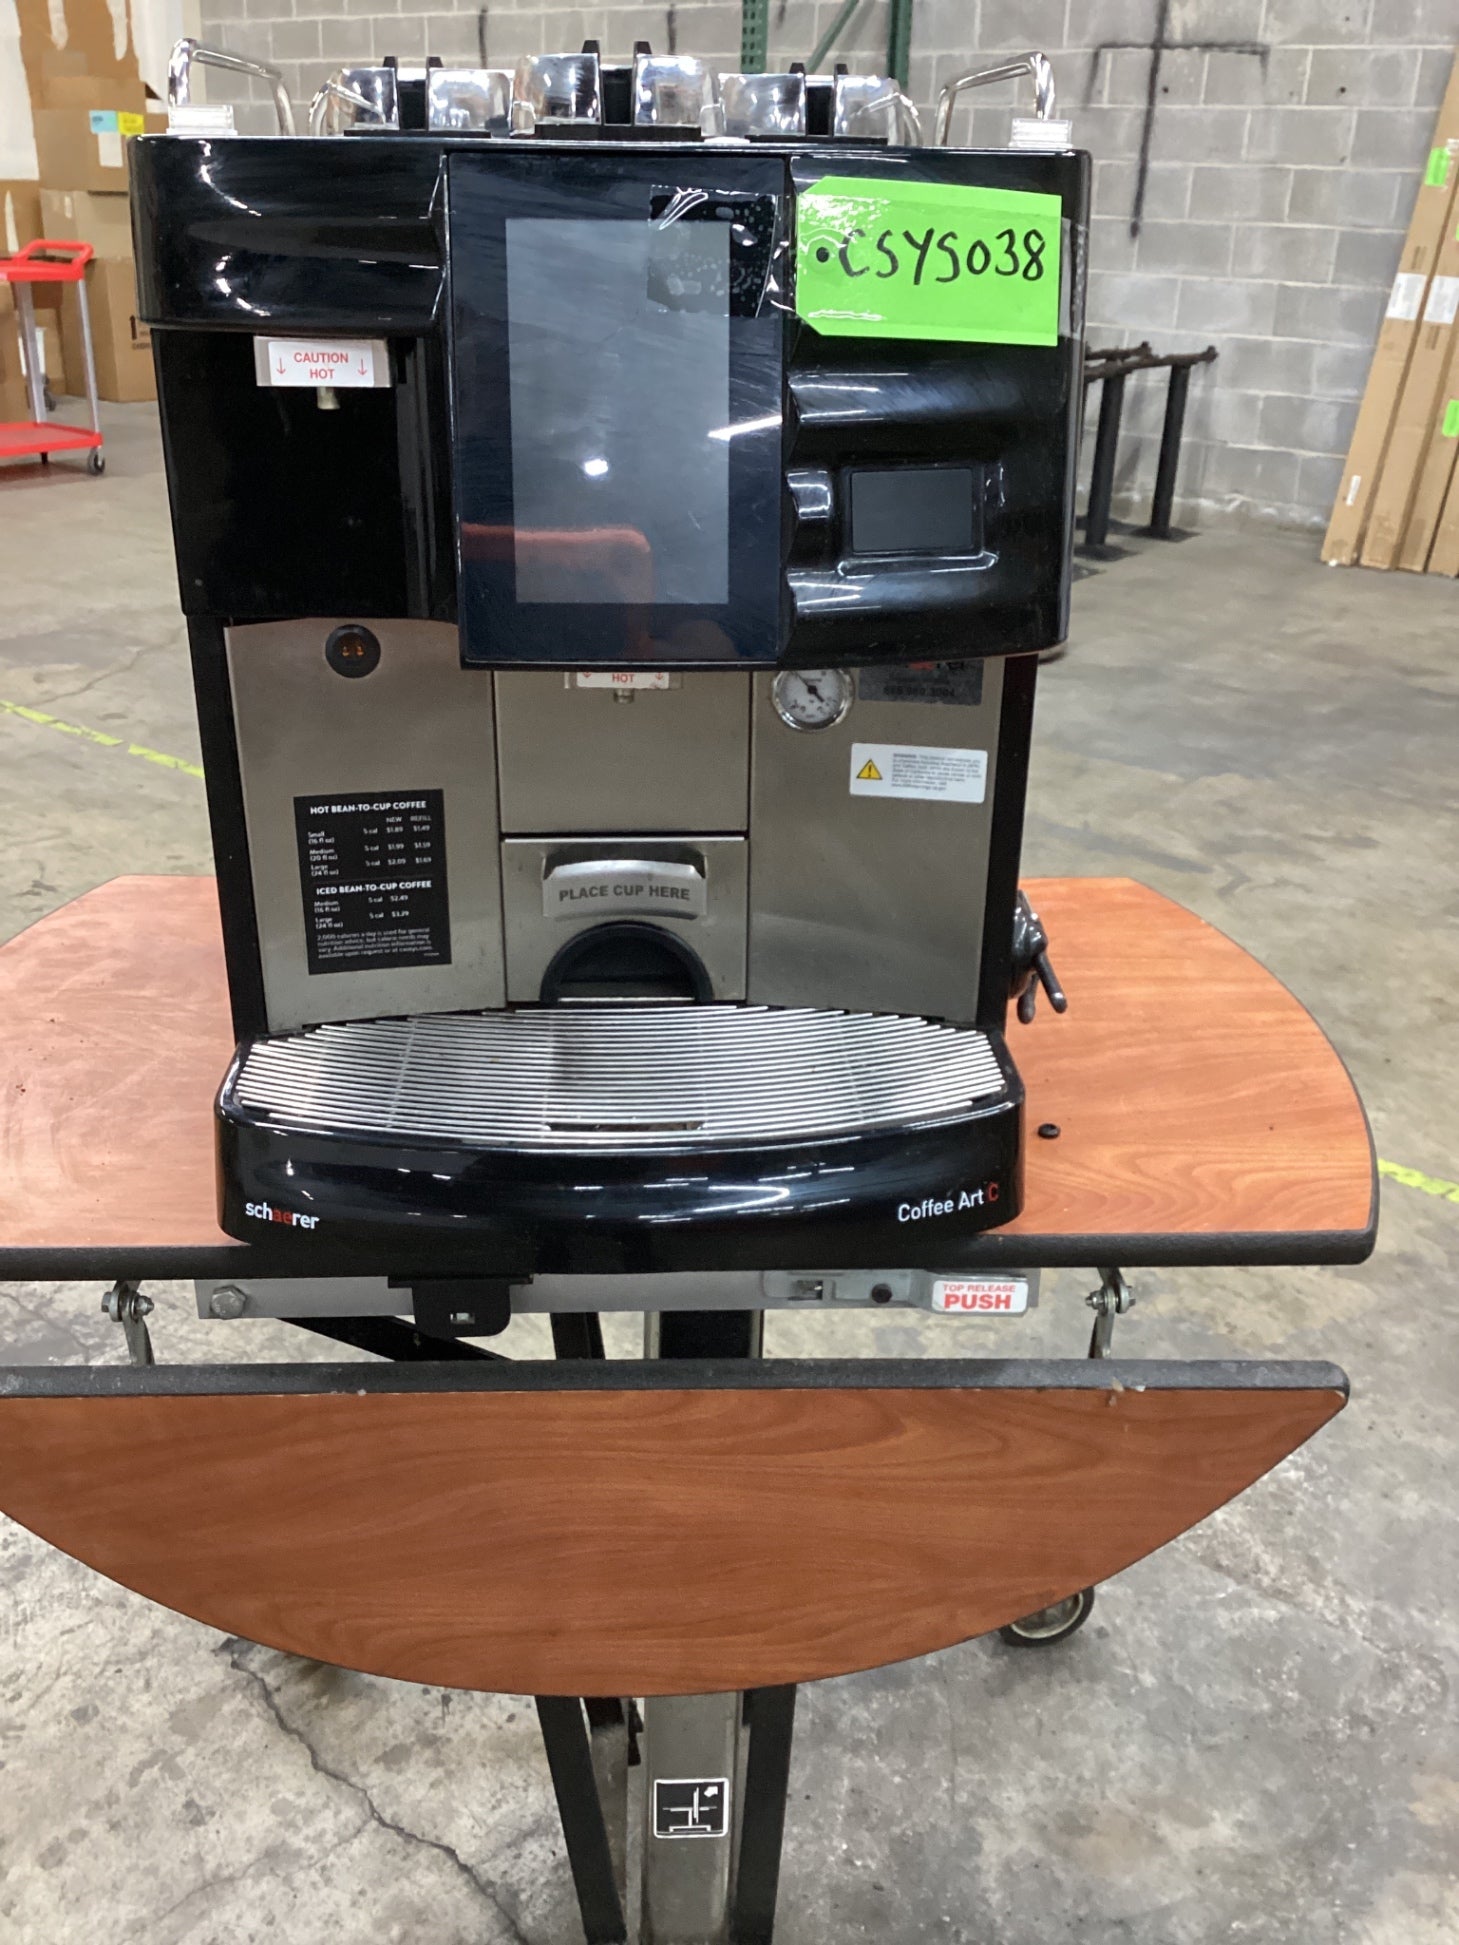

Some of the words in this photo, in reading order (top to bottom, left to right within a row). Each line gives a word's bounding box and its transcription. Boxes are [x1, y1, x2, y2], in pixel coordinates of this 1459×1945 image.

[294, 352, 348, 364] CAUTION
[310, 369, 335, 379] HOT
[612, 674, 635, 683] HOT
[310, 806, 329, 815] HOT
[331, 802, 392, 814] BEAN-TO-CUP
[393, 800, 427, 810] COFFEE
[316, 887, 337, 895] ICED
[339, 882, 398, 893] BEAN-TO-CUP
[399, 880, 432, 889] COFFEE
[559, 885, 609, 902] PLACE
[613, 884, 644, 896] CUP
[649, 885, 691, 901] HERE
[898, 1198, 954, 1222] Coffee
[958, 1188, 985, 1211] Art
[987, 1182, 999, 1202] C
[245, 1201, 320, 1230] schaerer
[943, 1284, 964, 1292] TOP
[967, 1284, 1016, 1293] RELEASE
[944, 1293, 1012, 1310] PUSH
